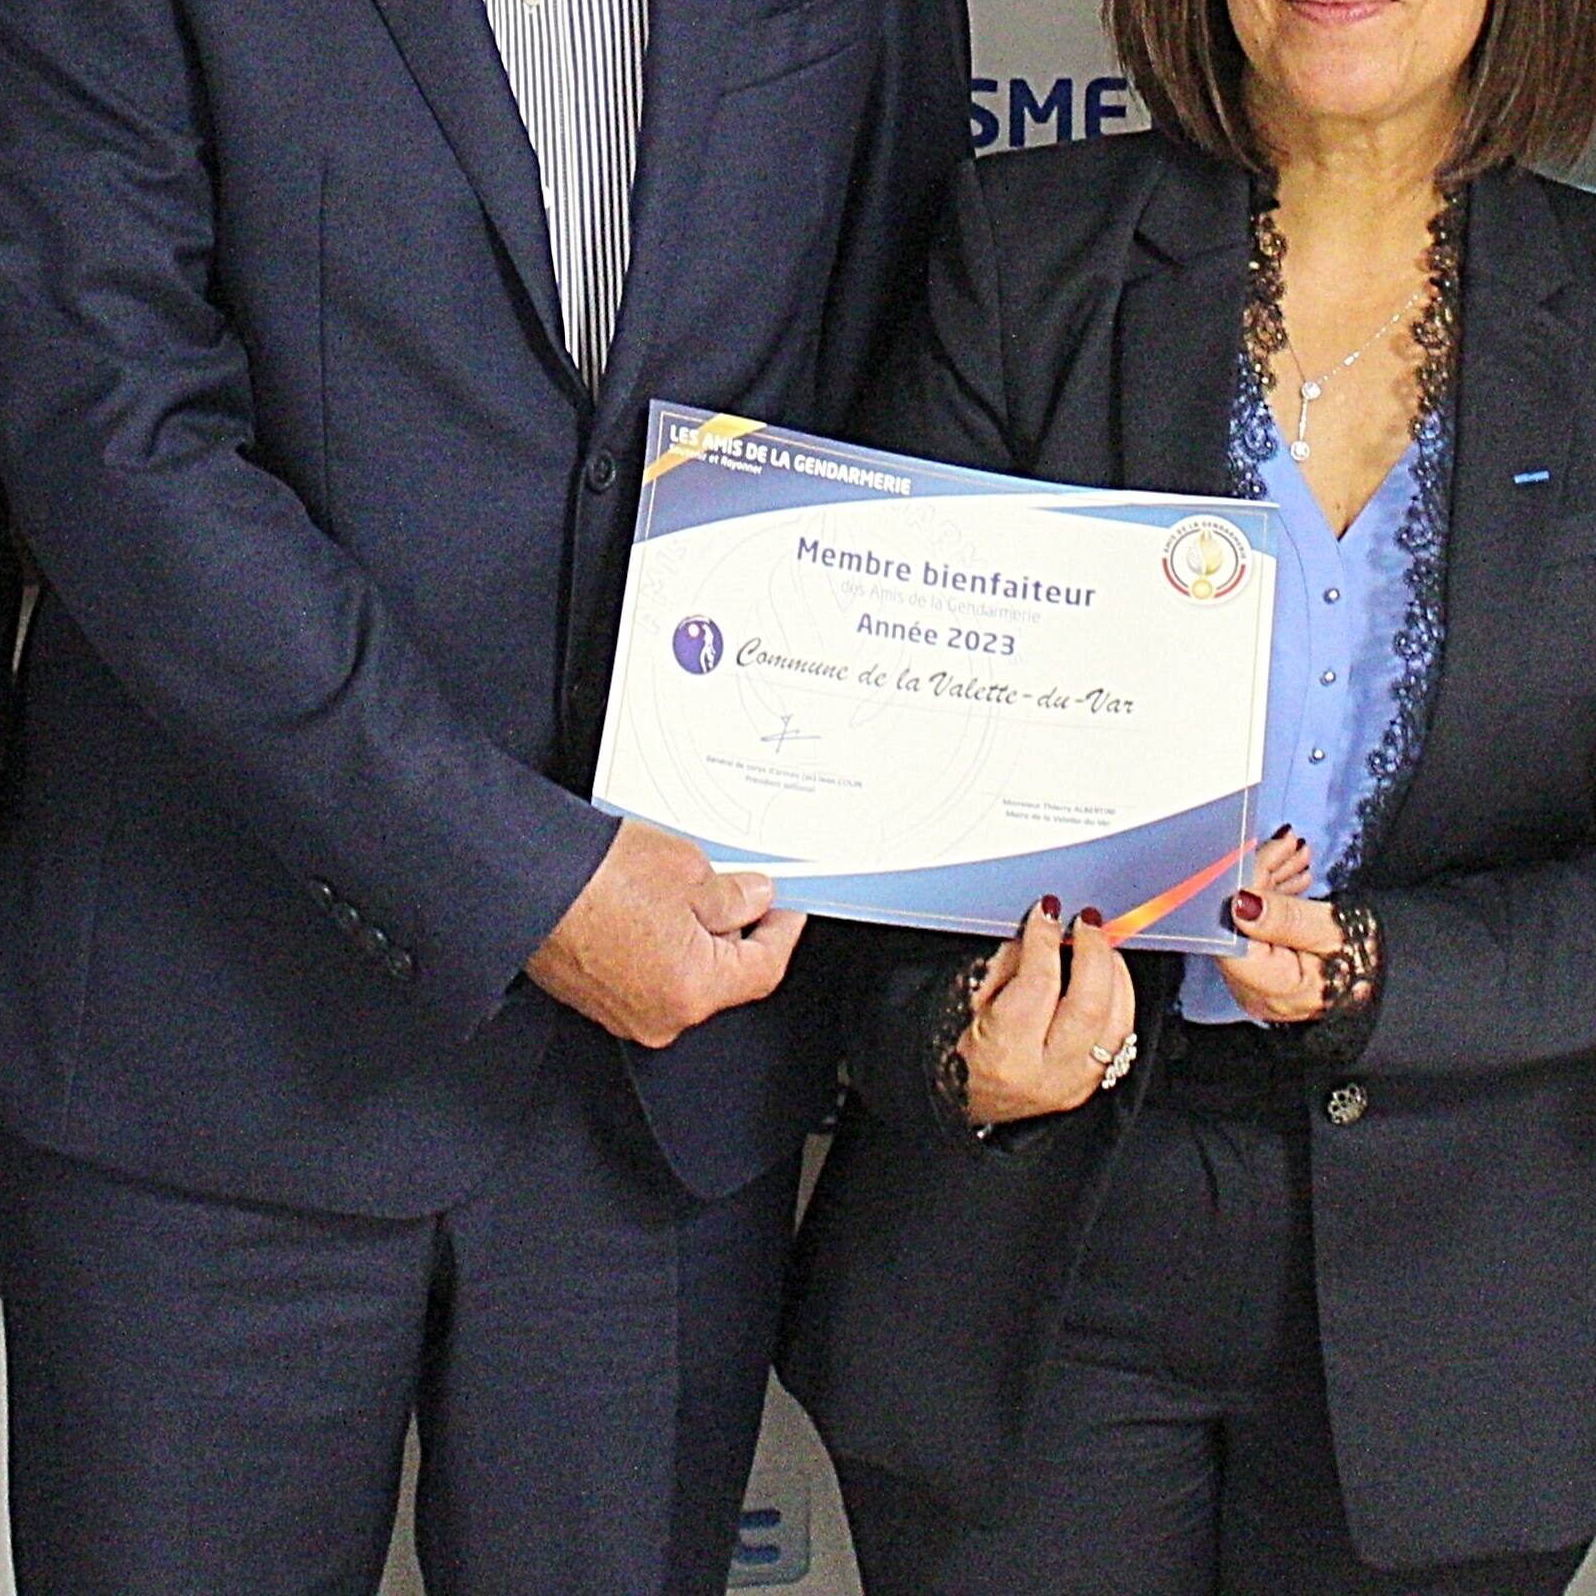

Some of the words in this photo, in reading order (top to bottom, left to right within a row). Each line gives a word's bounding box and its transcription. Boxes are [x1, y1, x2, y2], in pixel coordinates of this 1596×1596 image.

[669, 424, 700, 446] LES
[702, 432, 744, 458] AMIS
[745, 441, 769, 464] DE
[770, 448, 791, 470] LA
[793, 453, 912, 496] GENDARMERIE
[796, 535, 912, 582] Membre
[922, 560, 1097, 608] bienfaiteur
[840, 578, 866, 598] des
[870, 582, 906, 605] Amis
[908, 591, 928, 610] de
[930, 594, 945, 612] la
[946, 596, 1042, 625] Gendarmerie
[856, 612, 939, 646] Année
[946, 626, 1017, 657] 2023
[735, 636, 850, 682] Commune
[857, 662, 888, 689] de
[895, 666, 922, 693] la
[928, 669, 1136, 716] Valette-du-Var
